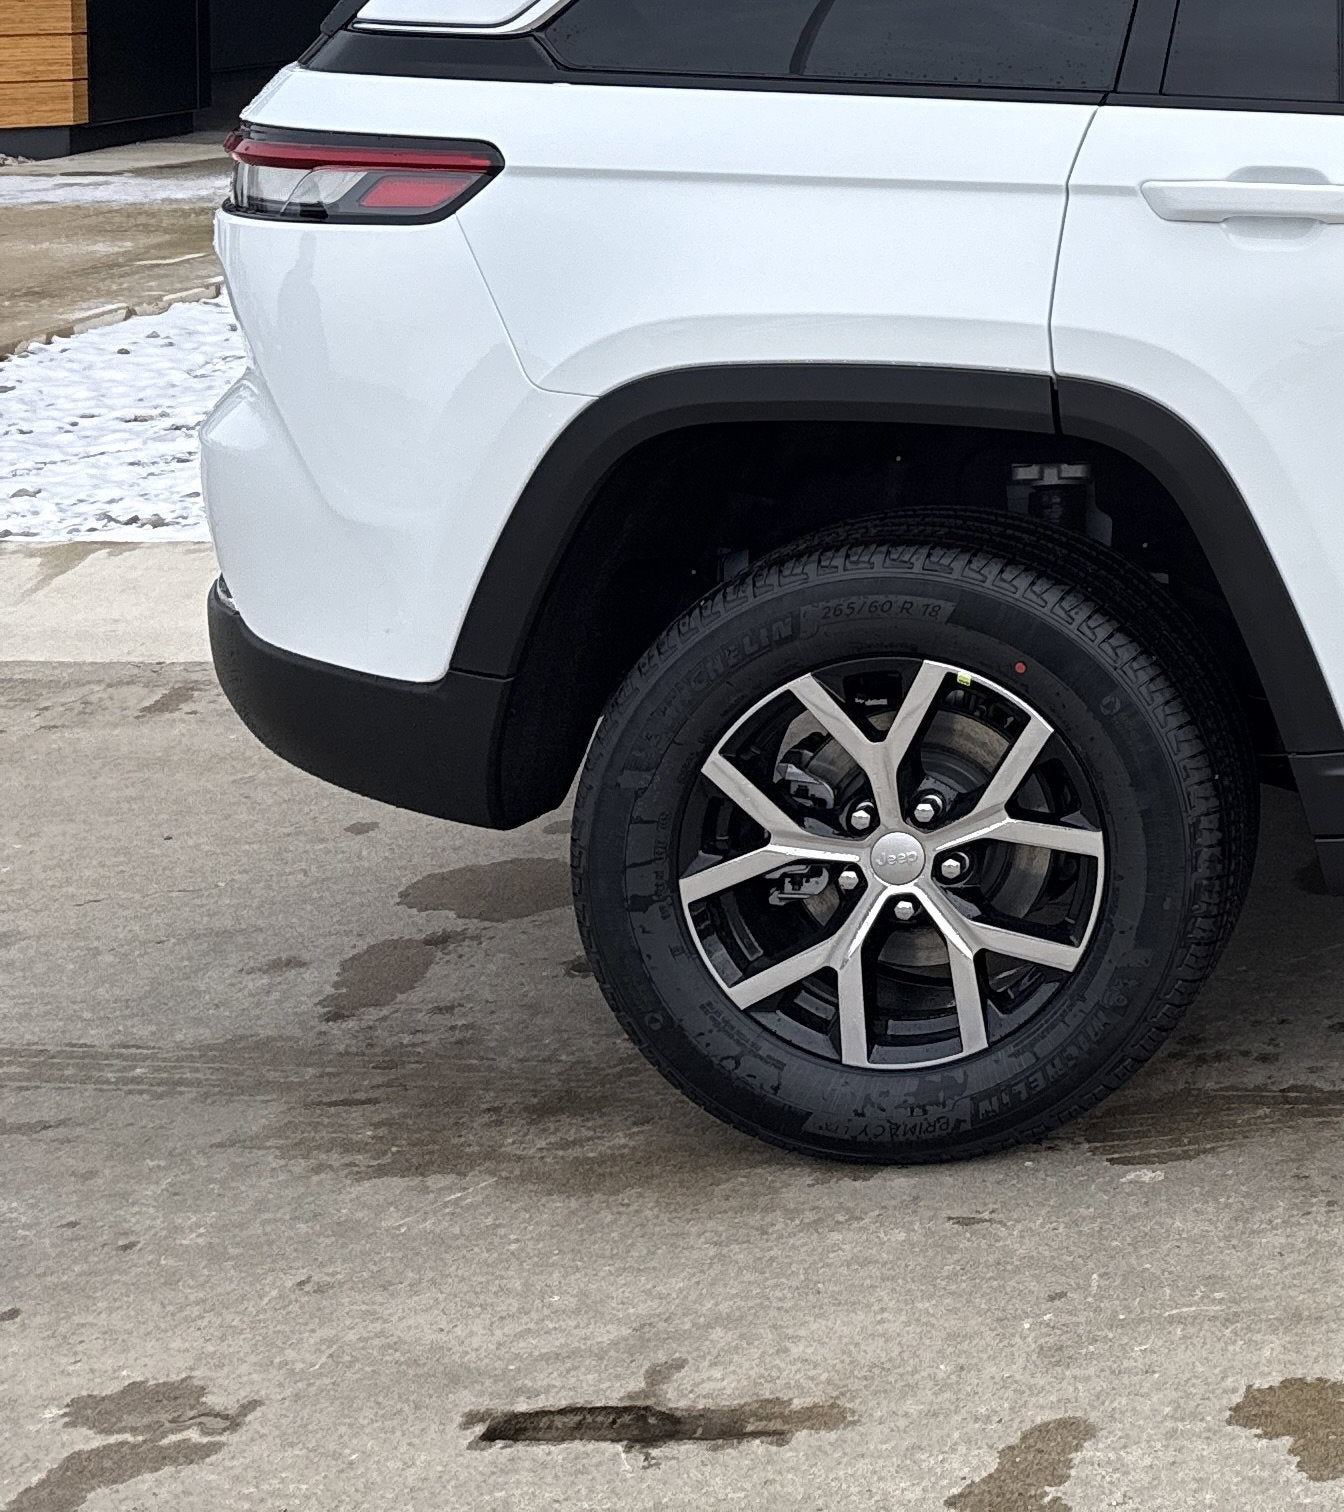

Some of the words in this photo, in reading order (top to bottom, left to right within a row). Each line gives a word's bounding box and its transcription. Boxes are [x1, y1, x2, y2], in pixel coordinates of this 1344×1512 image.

[822, 599, 892, 619] 265/60
[898, 601, 913, 615] R
[921, 602, 941, 618] 18
[875, 850, 918, 868] Jeep
